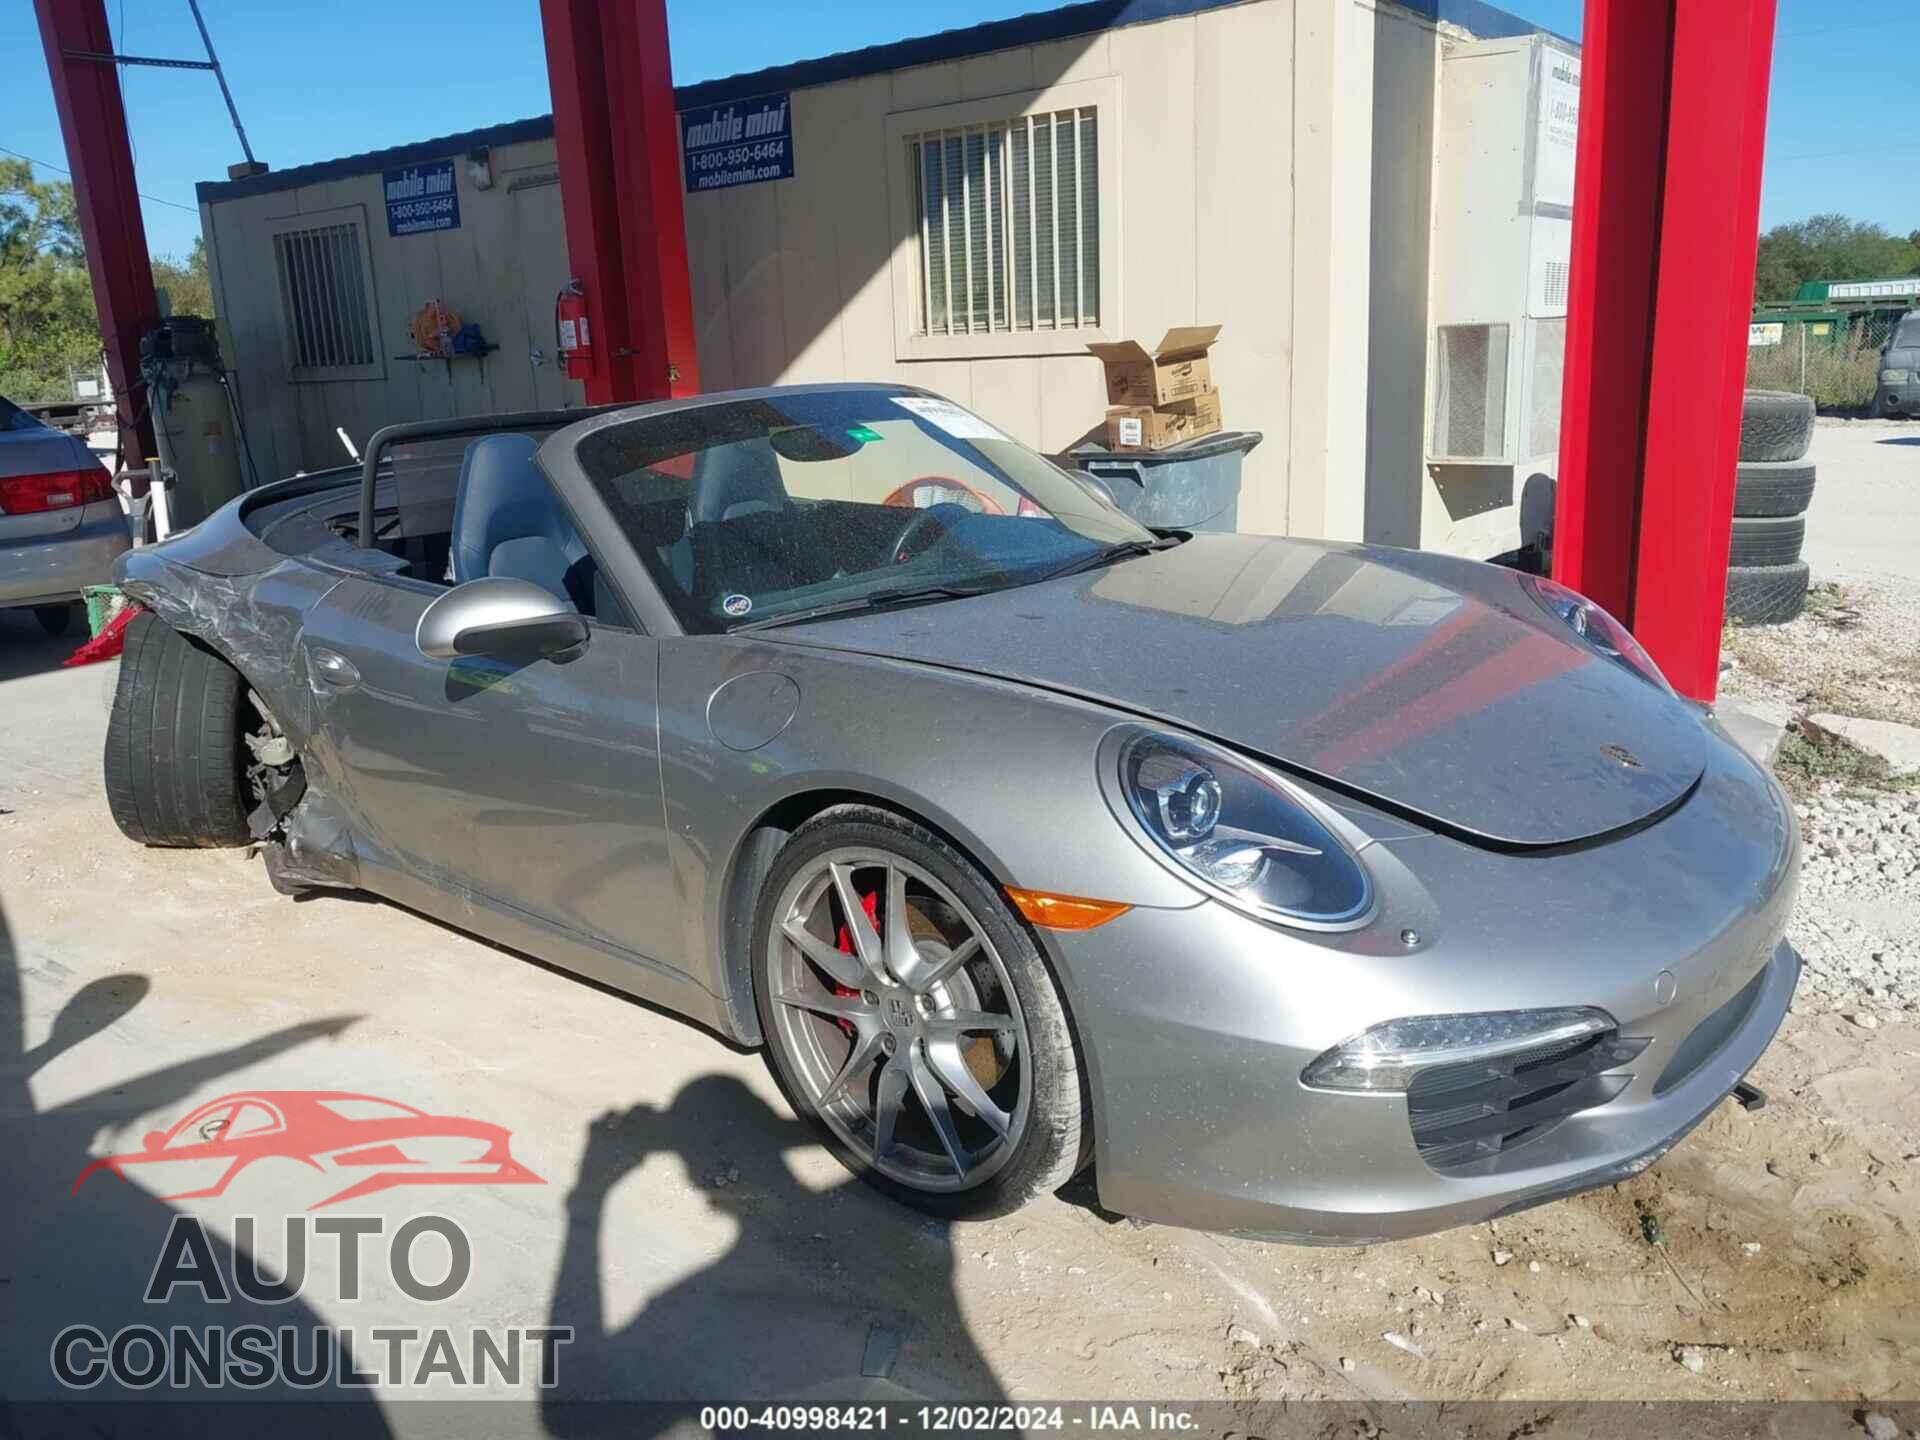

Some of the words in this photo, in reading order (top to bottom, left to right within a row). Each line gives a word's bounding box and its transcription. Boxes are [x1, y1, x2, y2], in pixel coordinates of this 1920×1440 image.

[687, 107, 743, 148] mobile
[745, 102, 786, 138] mini
[691, 141, 784, 171] 1-800-950-6464
[387, 168, 425, 200] mobile
[426, 166, 453, 194] mini
[698, 164, 780, 189] mobilemini.com
